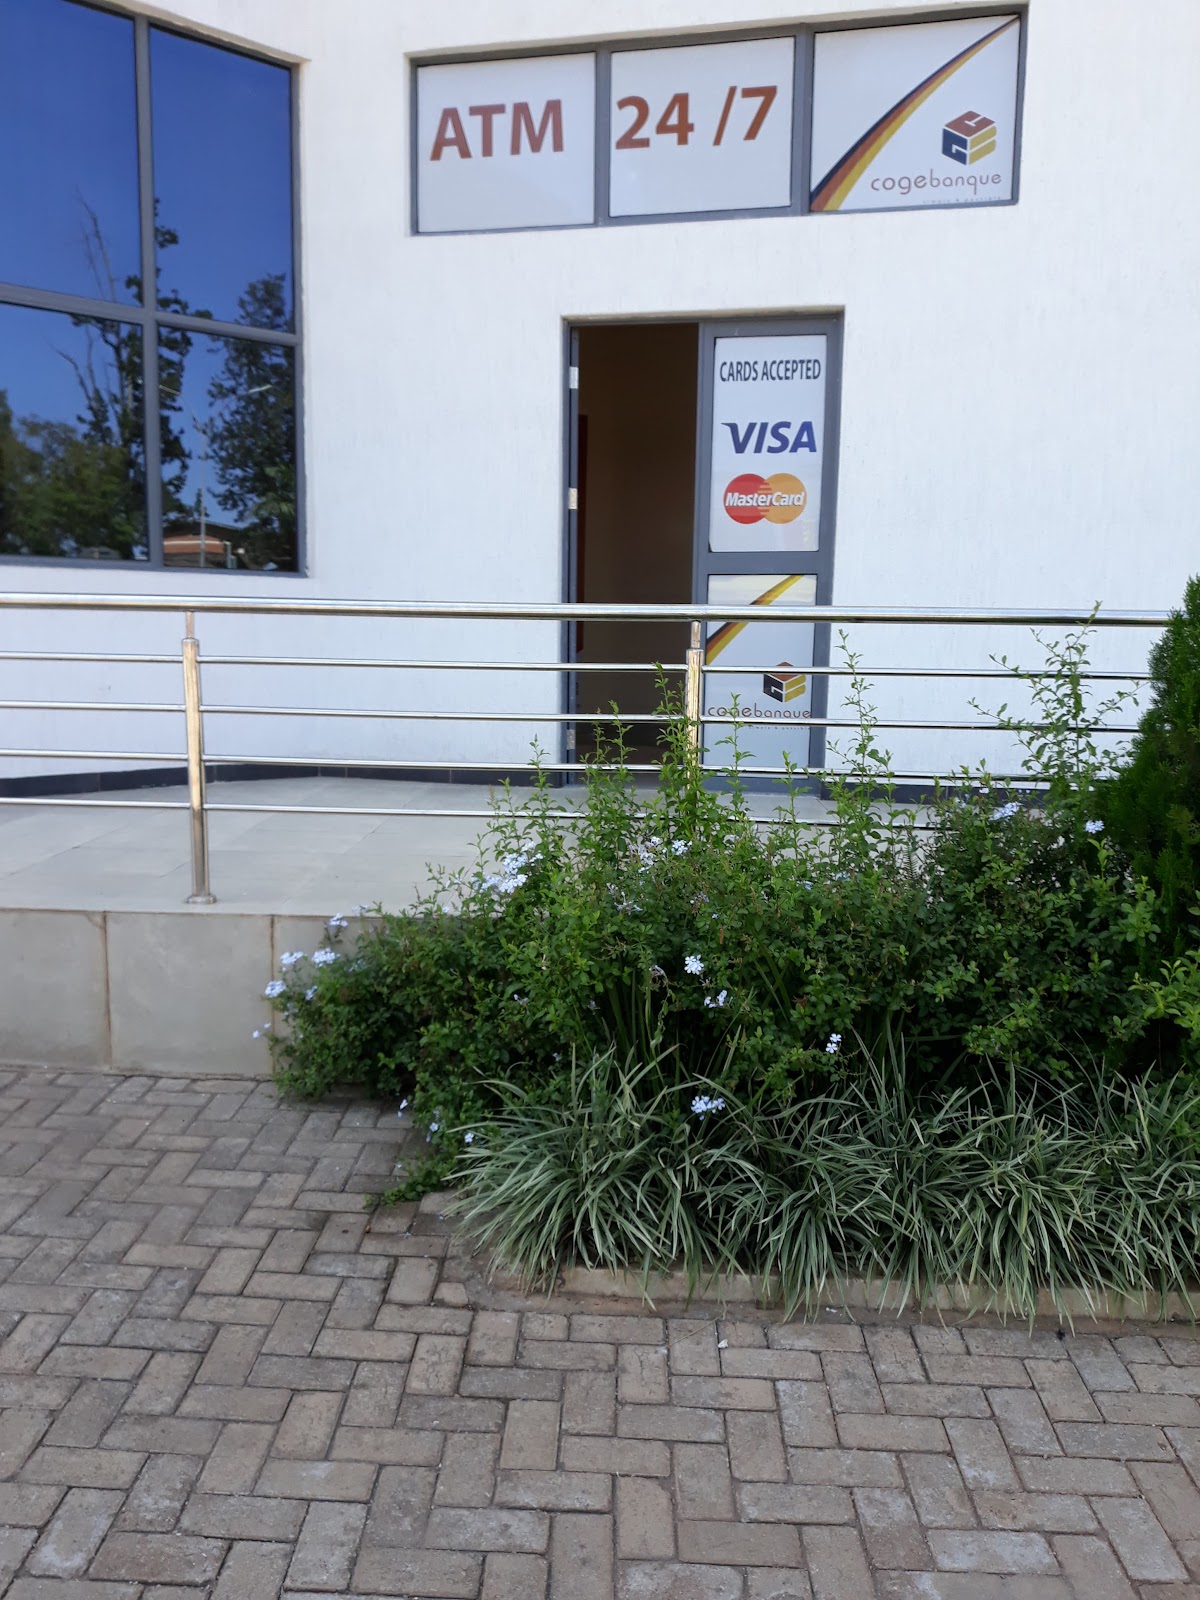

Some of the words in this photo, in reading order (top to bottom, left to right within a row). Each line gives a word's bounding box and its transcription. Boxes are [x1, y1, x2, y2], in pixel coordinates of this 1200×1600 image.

[430, 99, 564, 161] ATM
[871, 168, 1002, 195] cogebanque
[719, 360, 758, 382] CARDS
[761, 358, 821, 381] ACCEPTED
[720, 420, 817, 454] VISA
[725, 491, 805, 507] MasterCard
